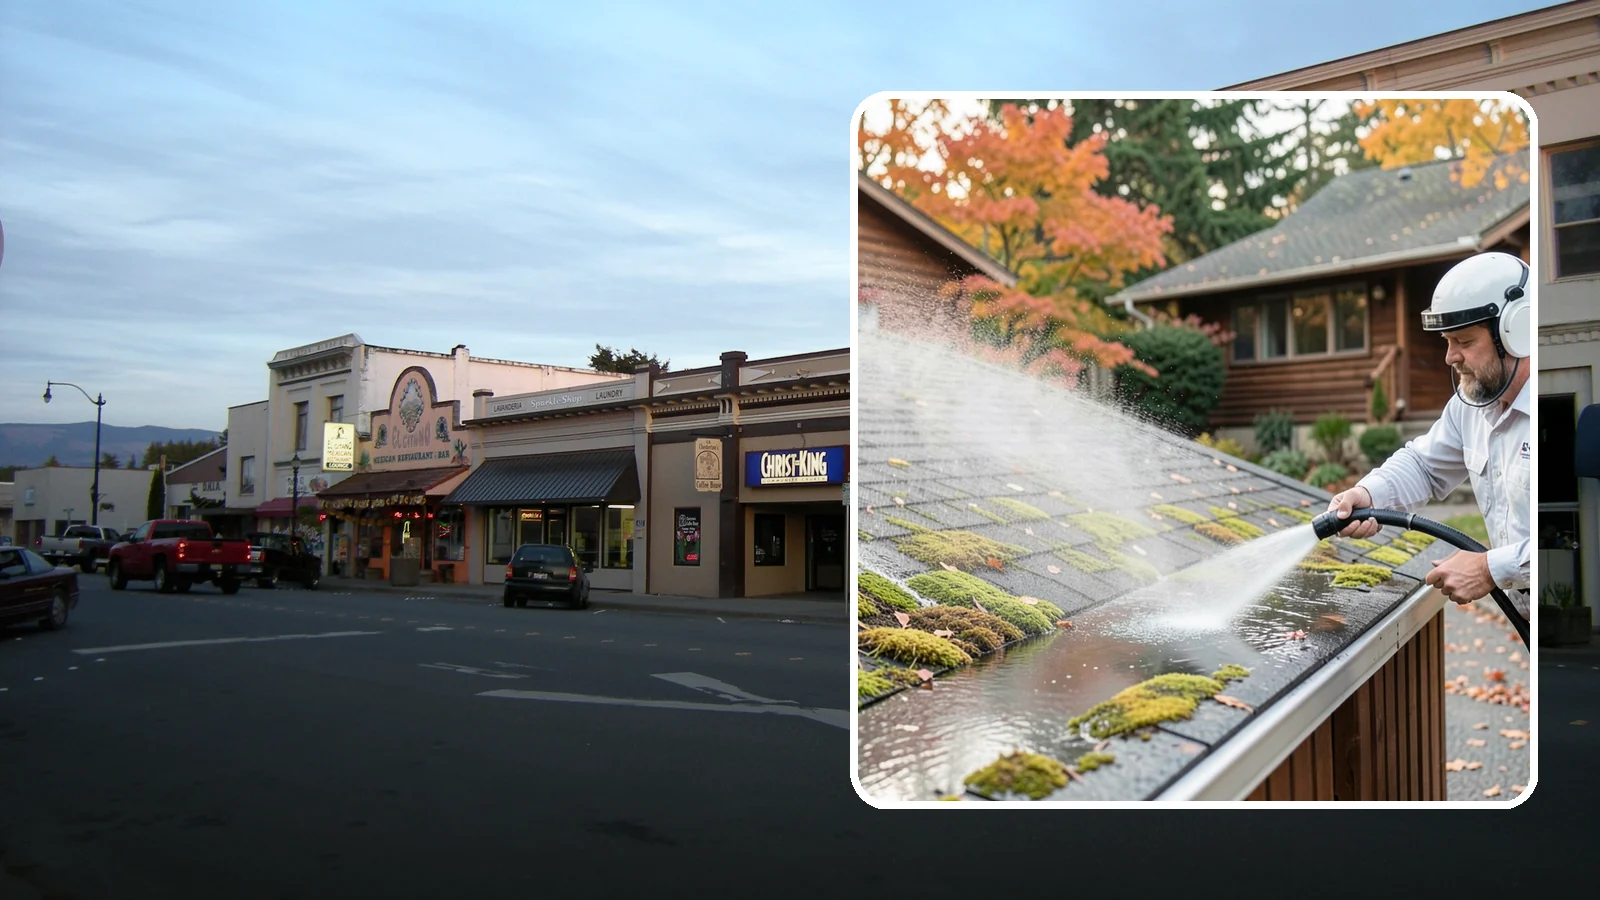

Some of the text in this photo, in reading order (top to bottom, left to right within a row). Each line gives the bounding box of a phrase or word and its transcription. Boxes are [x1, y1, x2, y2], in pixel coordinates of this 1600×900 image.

[595, 388, 624, 400] LAUNDRY
[493, 402, 523, 413] LAVANDERIA
[373, 450, 450, 464] MEXICAN RESTAURANT BAR
[760, 450, 827, 478] CHRIST KING
